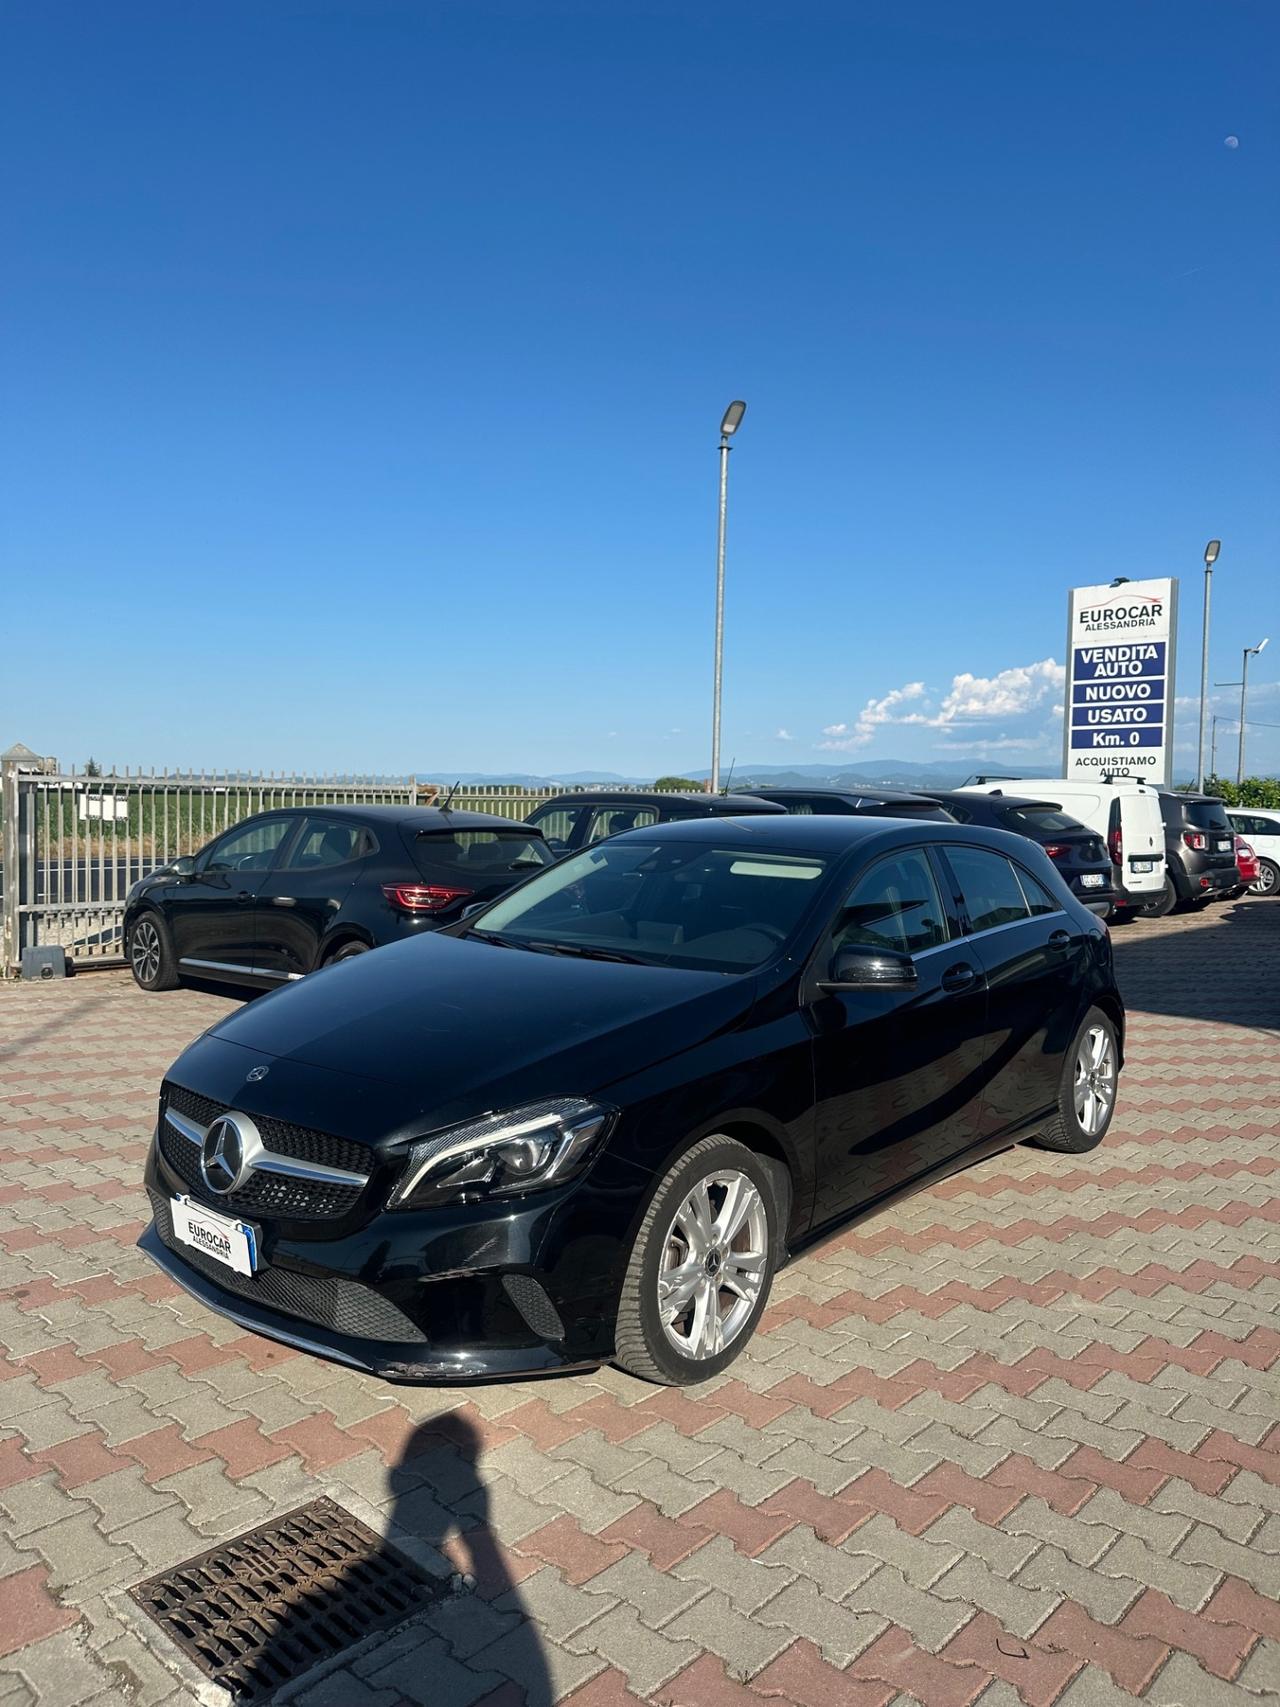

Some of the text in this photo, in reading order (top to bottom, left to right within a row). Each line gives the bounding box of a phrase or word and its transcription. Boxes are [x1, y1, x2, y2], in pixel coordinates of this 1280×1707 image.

[1079, 604, 1163, 624] EUROCAR
[1085, 618, 1156, 632] ALESSANDRIA
[1081, 644, 1158, 664] VENDITA
[1094, 661, 1143, 677] AUTO
[1085, 683, 1151, 701] NUOVO
[1087, 707, 1147, 724] USATO
[1092, 732, 1140, 746] Km. 0
[1075, 756, 1156, 767] ACQUISTIAMO
[1100, 767, 1130, 777] AUTO
[188, 1221, 231, 1254] EUROCAR
[193, 1235, 230, 1260] ALESSANDRIA
